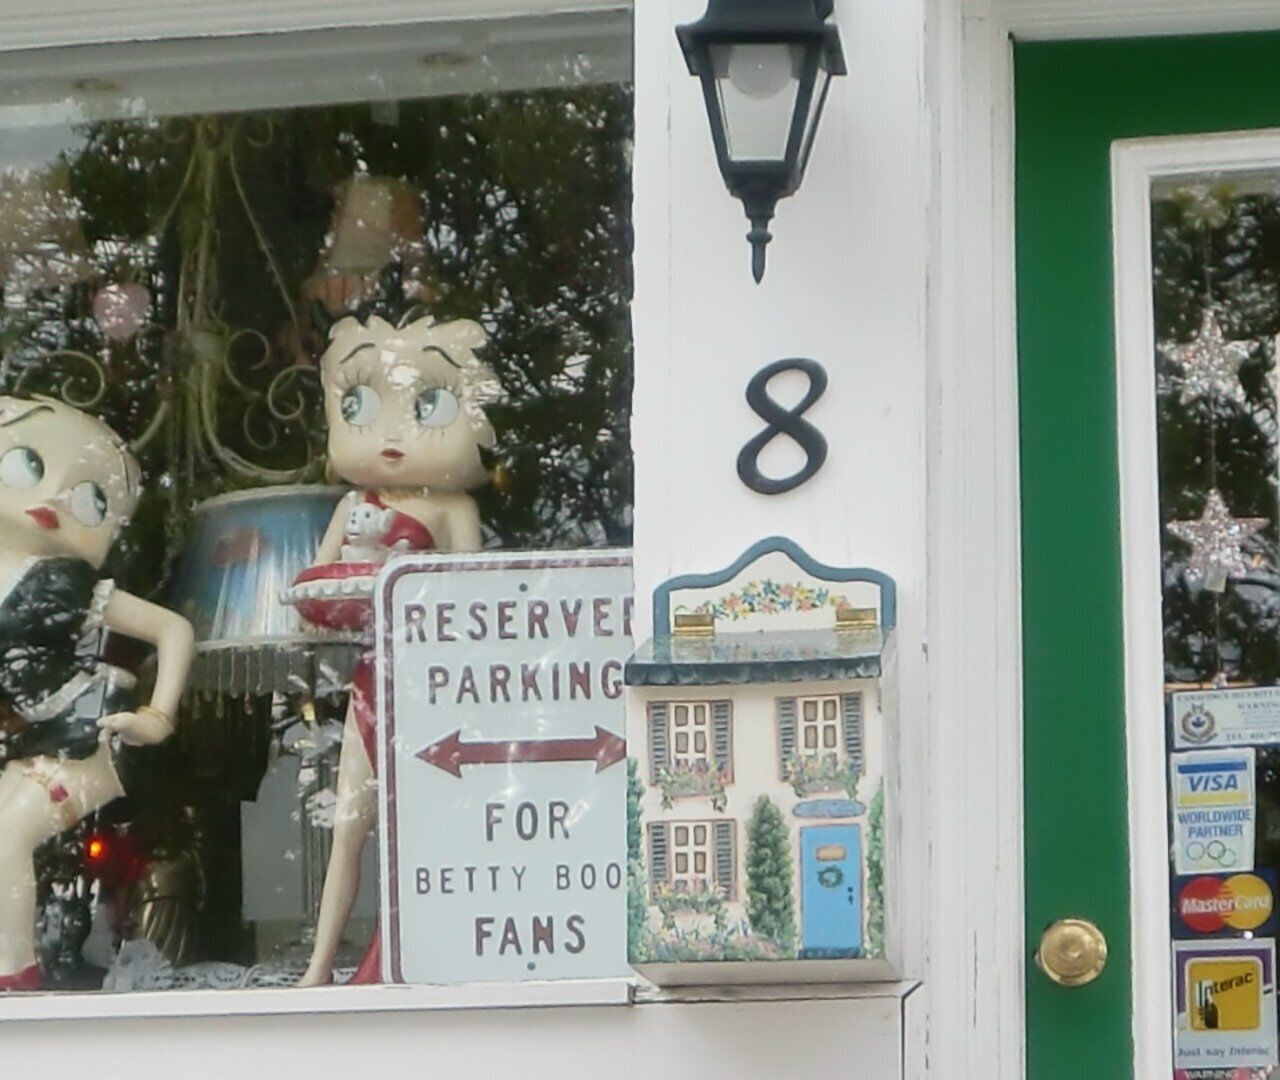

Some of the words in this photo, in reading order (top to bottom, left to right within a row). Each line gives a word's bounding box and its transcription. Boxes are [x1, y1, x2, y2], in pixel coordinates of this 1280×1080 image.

[736, 357, 829, 496] 8
[427, 660, 623, 706] PARKING
[1187, 774, 1240, 793] VISA
[484, 800, 572, 842] FOR
[1177, 808, 1253, 825] WORLDWIDE
[1187, 824, 1244, 839] PARTNER
[415, 864, 528, 896] BETTY
[555, 860, 622, 892] BOO
[1181, 894, 1271, 915] MasterCard
[474, 914, 587, 957] FANS
[1197, 971, 1255, 1008] Interac
